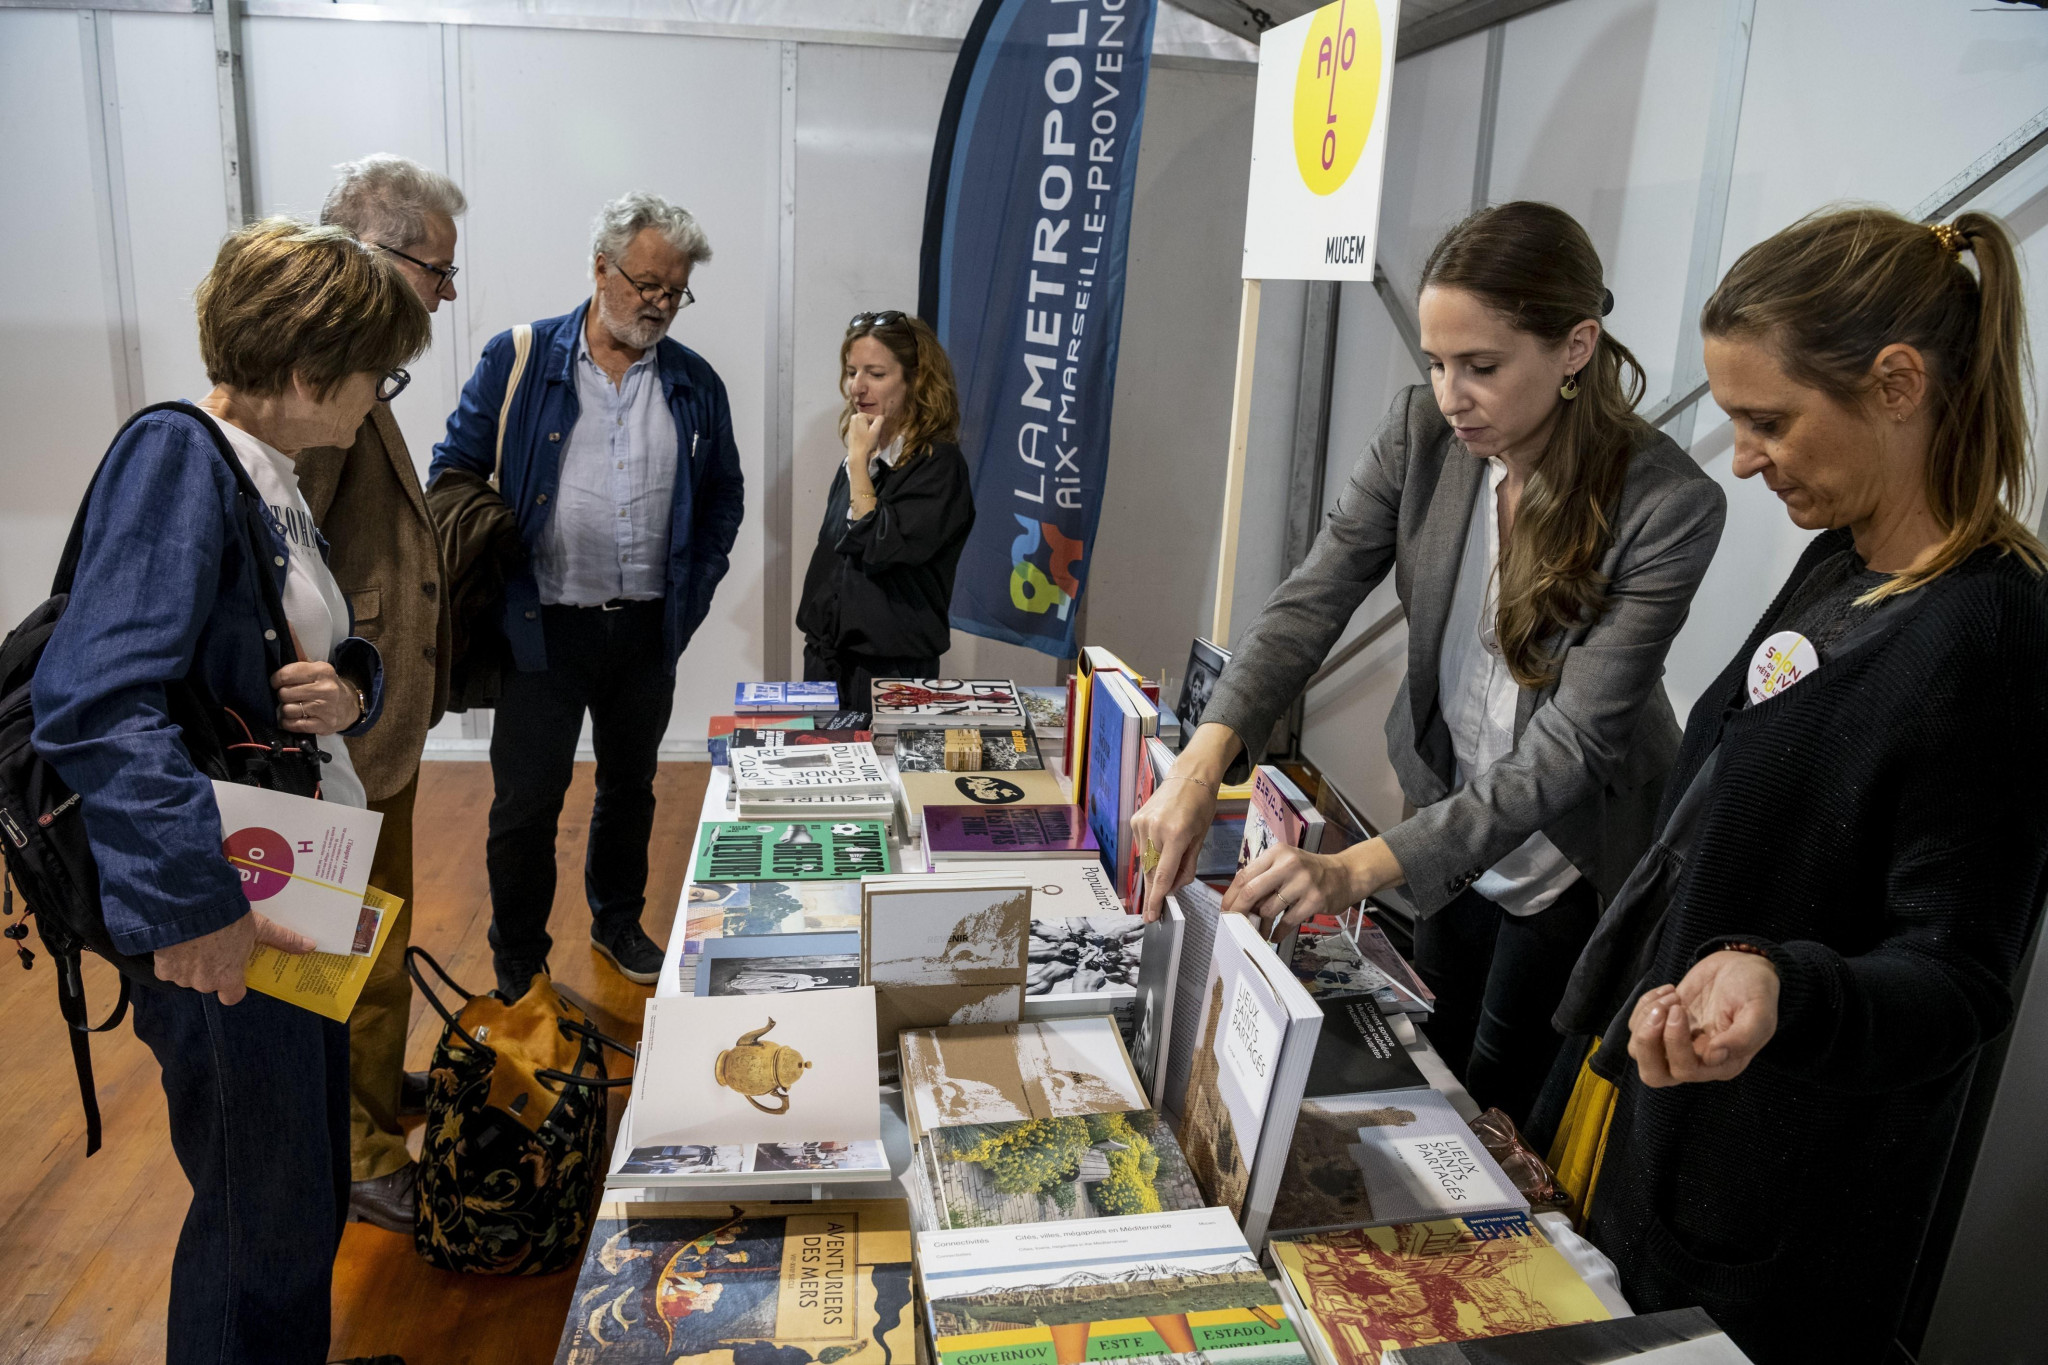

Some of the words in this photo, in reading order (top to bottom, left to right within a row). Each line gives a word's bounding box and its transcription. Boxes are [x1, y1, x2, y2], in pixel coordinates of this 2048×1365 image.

[1021, 0, 1089, 412] METROPOL
[1325, 235, 1365, 264] MUCEM
[1014, 422, 1049, 504] LA
[859, 765, 882, 782] UNE
[1082, 866, 1119, 912] Populaire?
[1236, 998, 1259, 1043] SAINTS
[1239, 982, 1259, 1022] LIEUX
[1355, 1003, 1375, 1032] Musiques
[1345, 1004, 1366, 1034] musiques
[1363, 1034, 1382, 1059] vivantes
[1364, 1002, 1383, 1026] L'Orient
[1378, 1026, 1395, 1047] sonore
[1233, 1014, 1265, 1078] PARTAGÉS
[1414, 1143, 1467, 1200] PARTAGÉS
[1429, 1142, 1469, 1180] SAINTS
[1445, 1141, 1480, 1173] LIEUX
[802, 1237, 821, 1263] DES
[933, 1238, 990, 1248] Connectivités
[1015, 1232, 1039, 1241] Cités,
[1040, 1230, 1063, 1239] villes,
[1063, 1227, 1107, 1238] mégapoles
[1119, 1222, 1173, 1233] Méditerranée
[1472, 1222, 1532, 1241] ALGER
[799, 1267, 819, 1308] MERS
[823, 1222, 845, 1325] AVENTURIERS
[956, 1346, 1048, 1365] GOVERNOV
[1203, 1325, 1266, 1341] ESTADO
